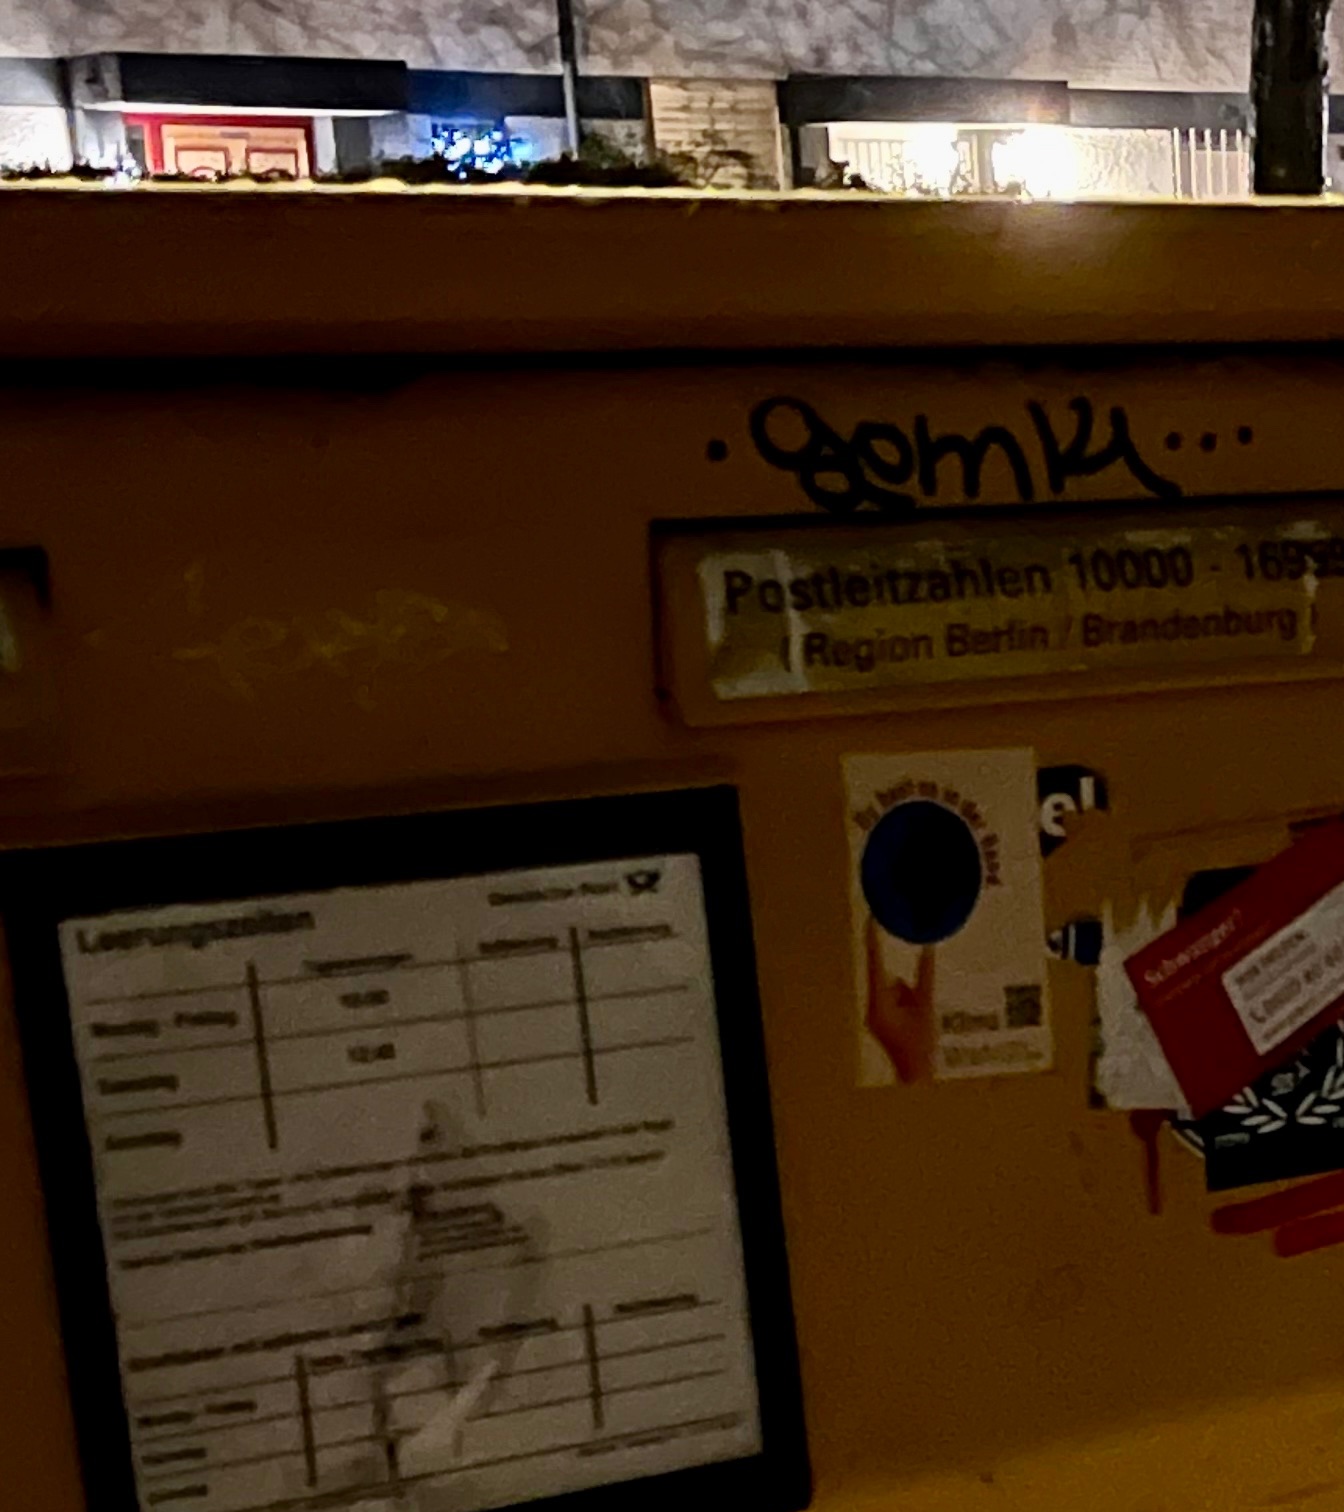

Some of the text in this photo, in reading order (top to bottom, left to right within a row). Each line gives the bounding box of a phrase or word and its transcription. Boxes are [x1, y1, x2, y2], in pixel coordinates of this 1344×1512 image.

[723, 557, 1051, 615] Postleitzahlen
[1068, 547, 1193, 592] 10000
[804, 628, 933, 672] Region
[946, 617, 1049, 658] Berlin
[1082, 602, 1298, 648] Brandenburg
